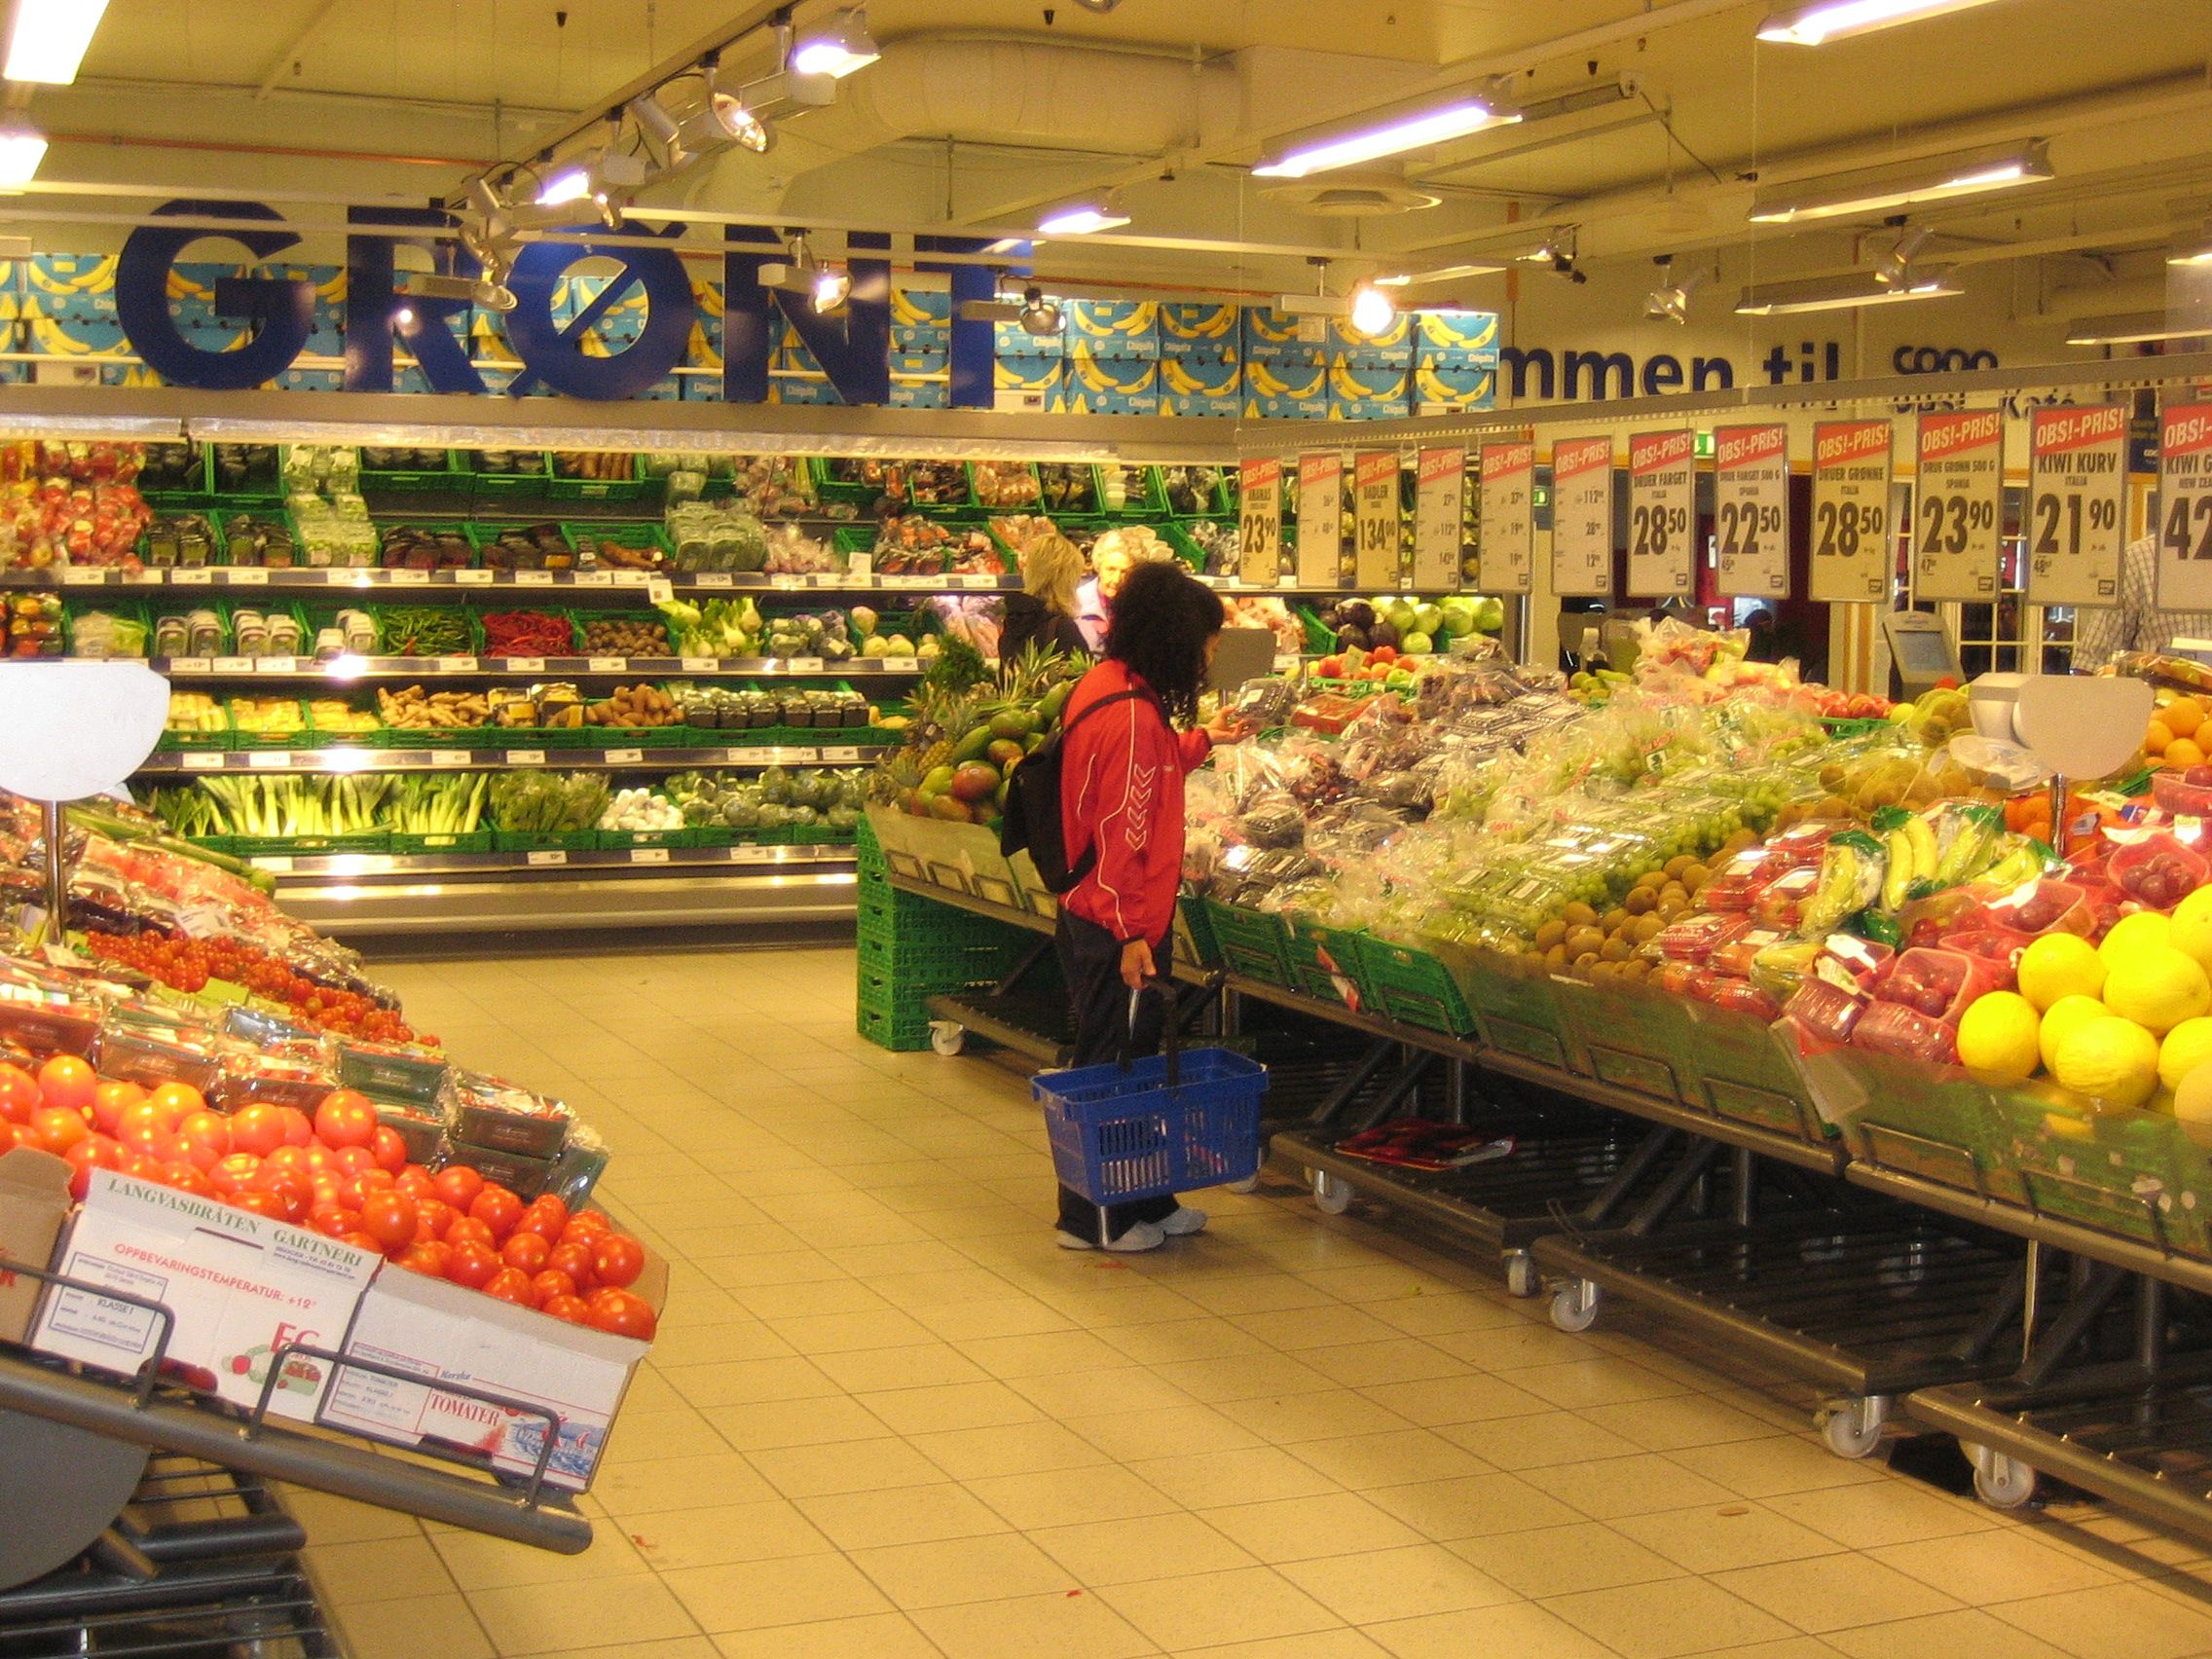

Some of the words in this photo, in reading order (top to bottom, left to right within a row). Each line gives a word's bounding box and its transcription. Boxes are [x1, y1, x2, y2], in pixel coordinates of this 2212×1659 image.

[115, 198, 1033, 407] GRØNT
[1718, 427, 1783, 464] OBS!-PRIS!
[1818, 424, 1890, 461] OBS!-PRIS!
[1922, 412, 2000, 453] OBS!-PRIS!
[2036, 407, 2124, 448] OBS!-PRIS!
[1634, 432, 1692, 468] OBS!-PRIS!
[1972, 460, 1988, 472] 500
[1989, 460, 1995, 472] G
[2038, 453, 2073, 474] KIWI
[2077, 452, 2118, 473] KURV
[2166, 456, 2198, 475] KIWI
[1659, 472, 1687, 486] FARGET
[108, 1178, 260, 1235] LANGVASBRÅTEN
[274, 1229, 364, 1268] GARTNERI
[114, 1242, 284, 1301] OPPBEVARINGSTEMPERATUR:
[430, 1393, 500, 1427] TOMATER
